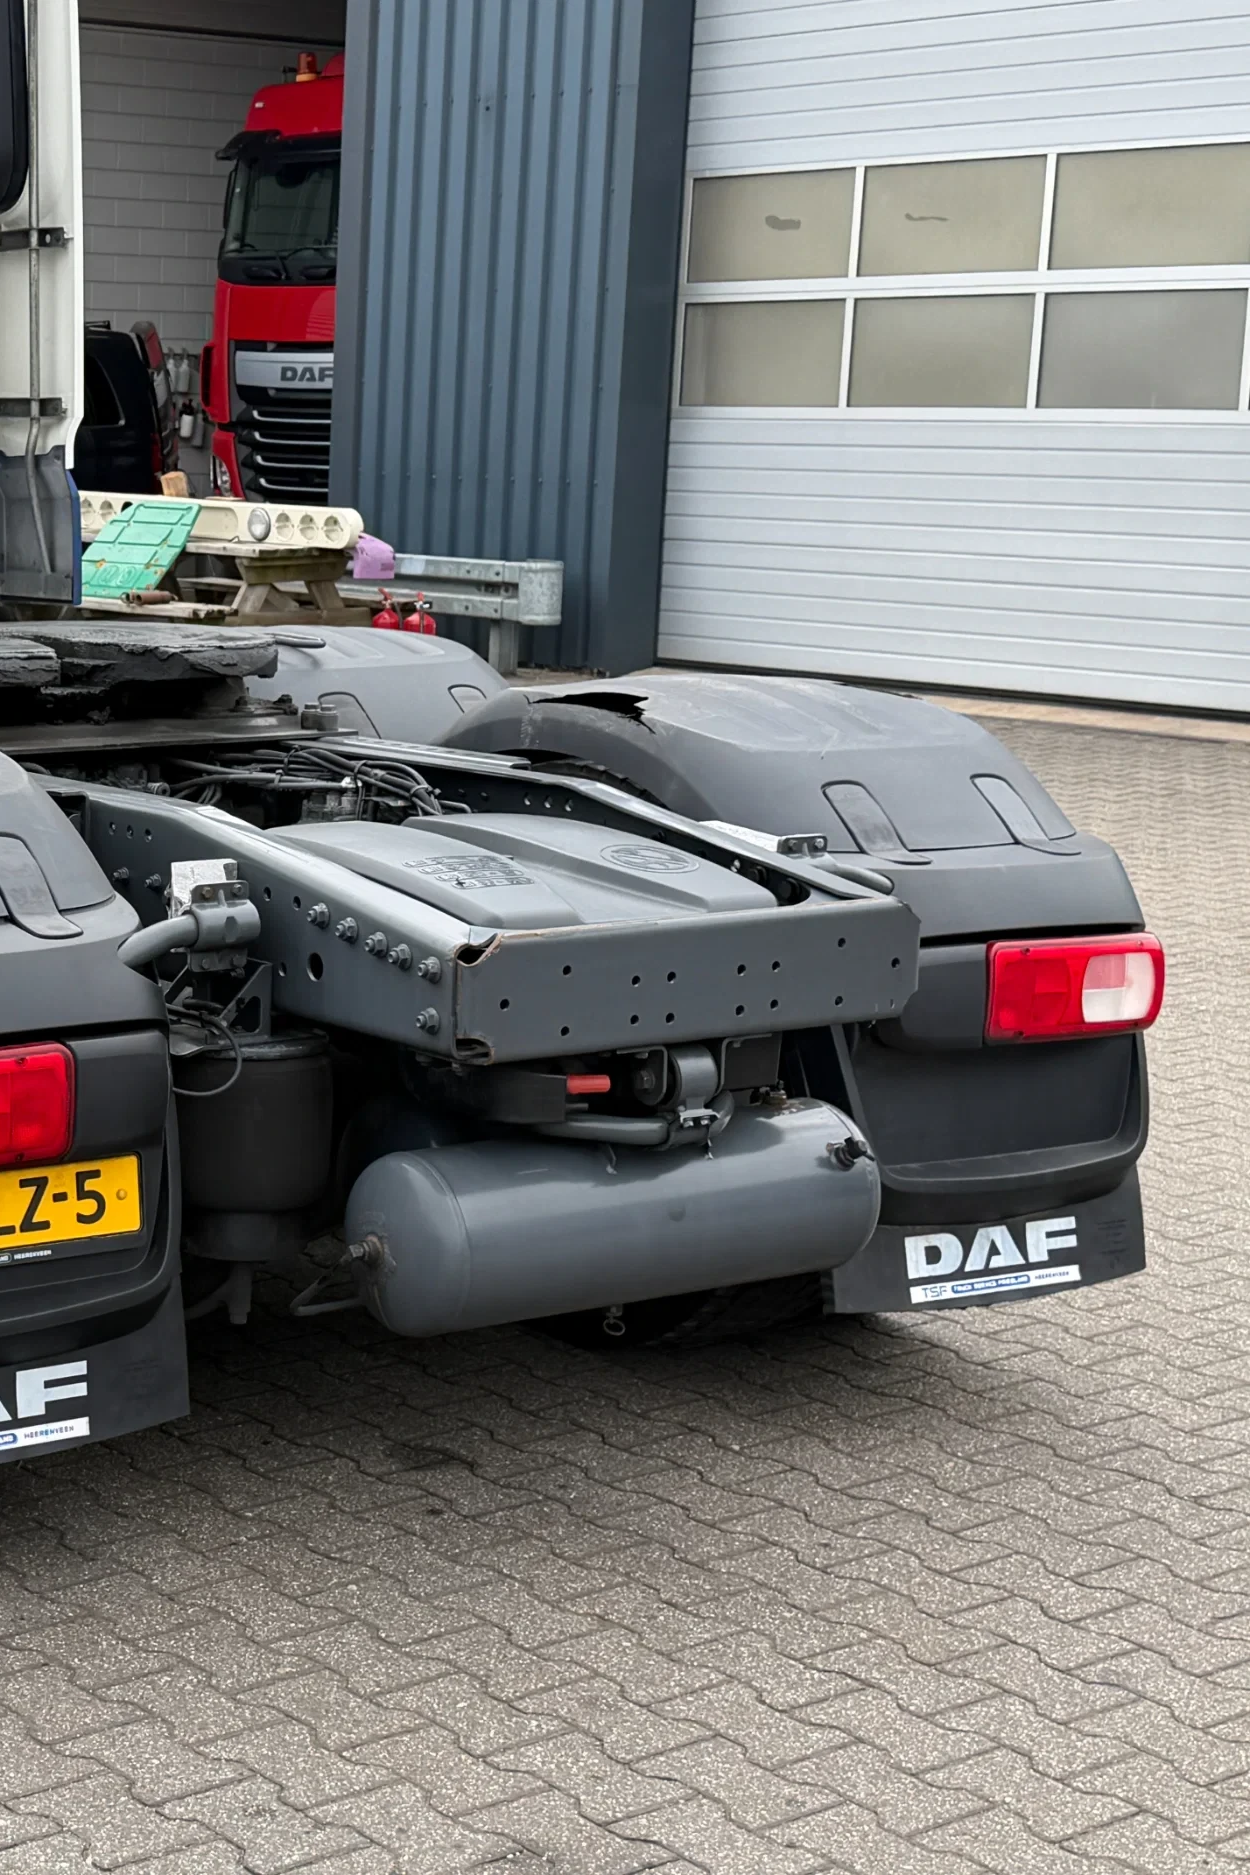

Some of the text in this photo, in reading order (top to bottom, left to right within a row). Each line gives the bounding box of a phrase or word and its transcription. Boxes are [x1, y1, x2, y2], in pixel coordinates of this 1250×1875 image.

[281, 366, 334, 382] DAF
[904, 1216, 1077, 1279] DAF
[922, 1285, 948, 1299] TSF
